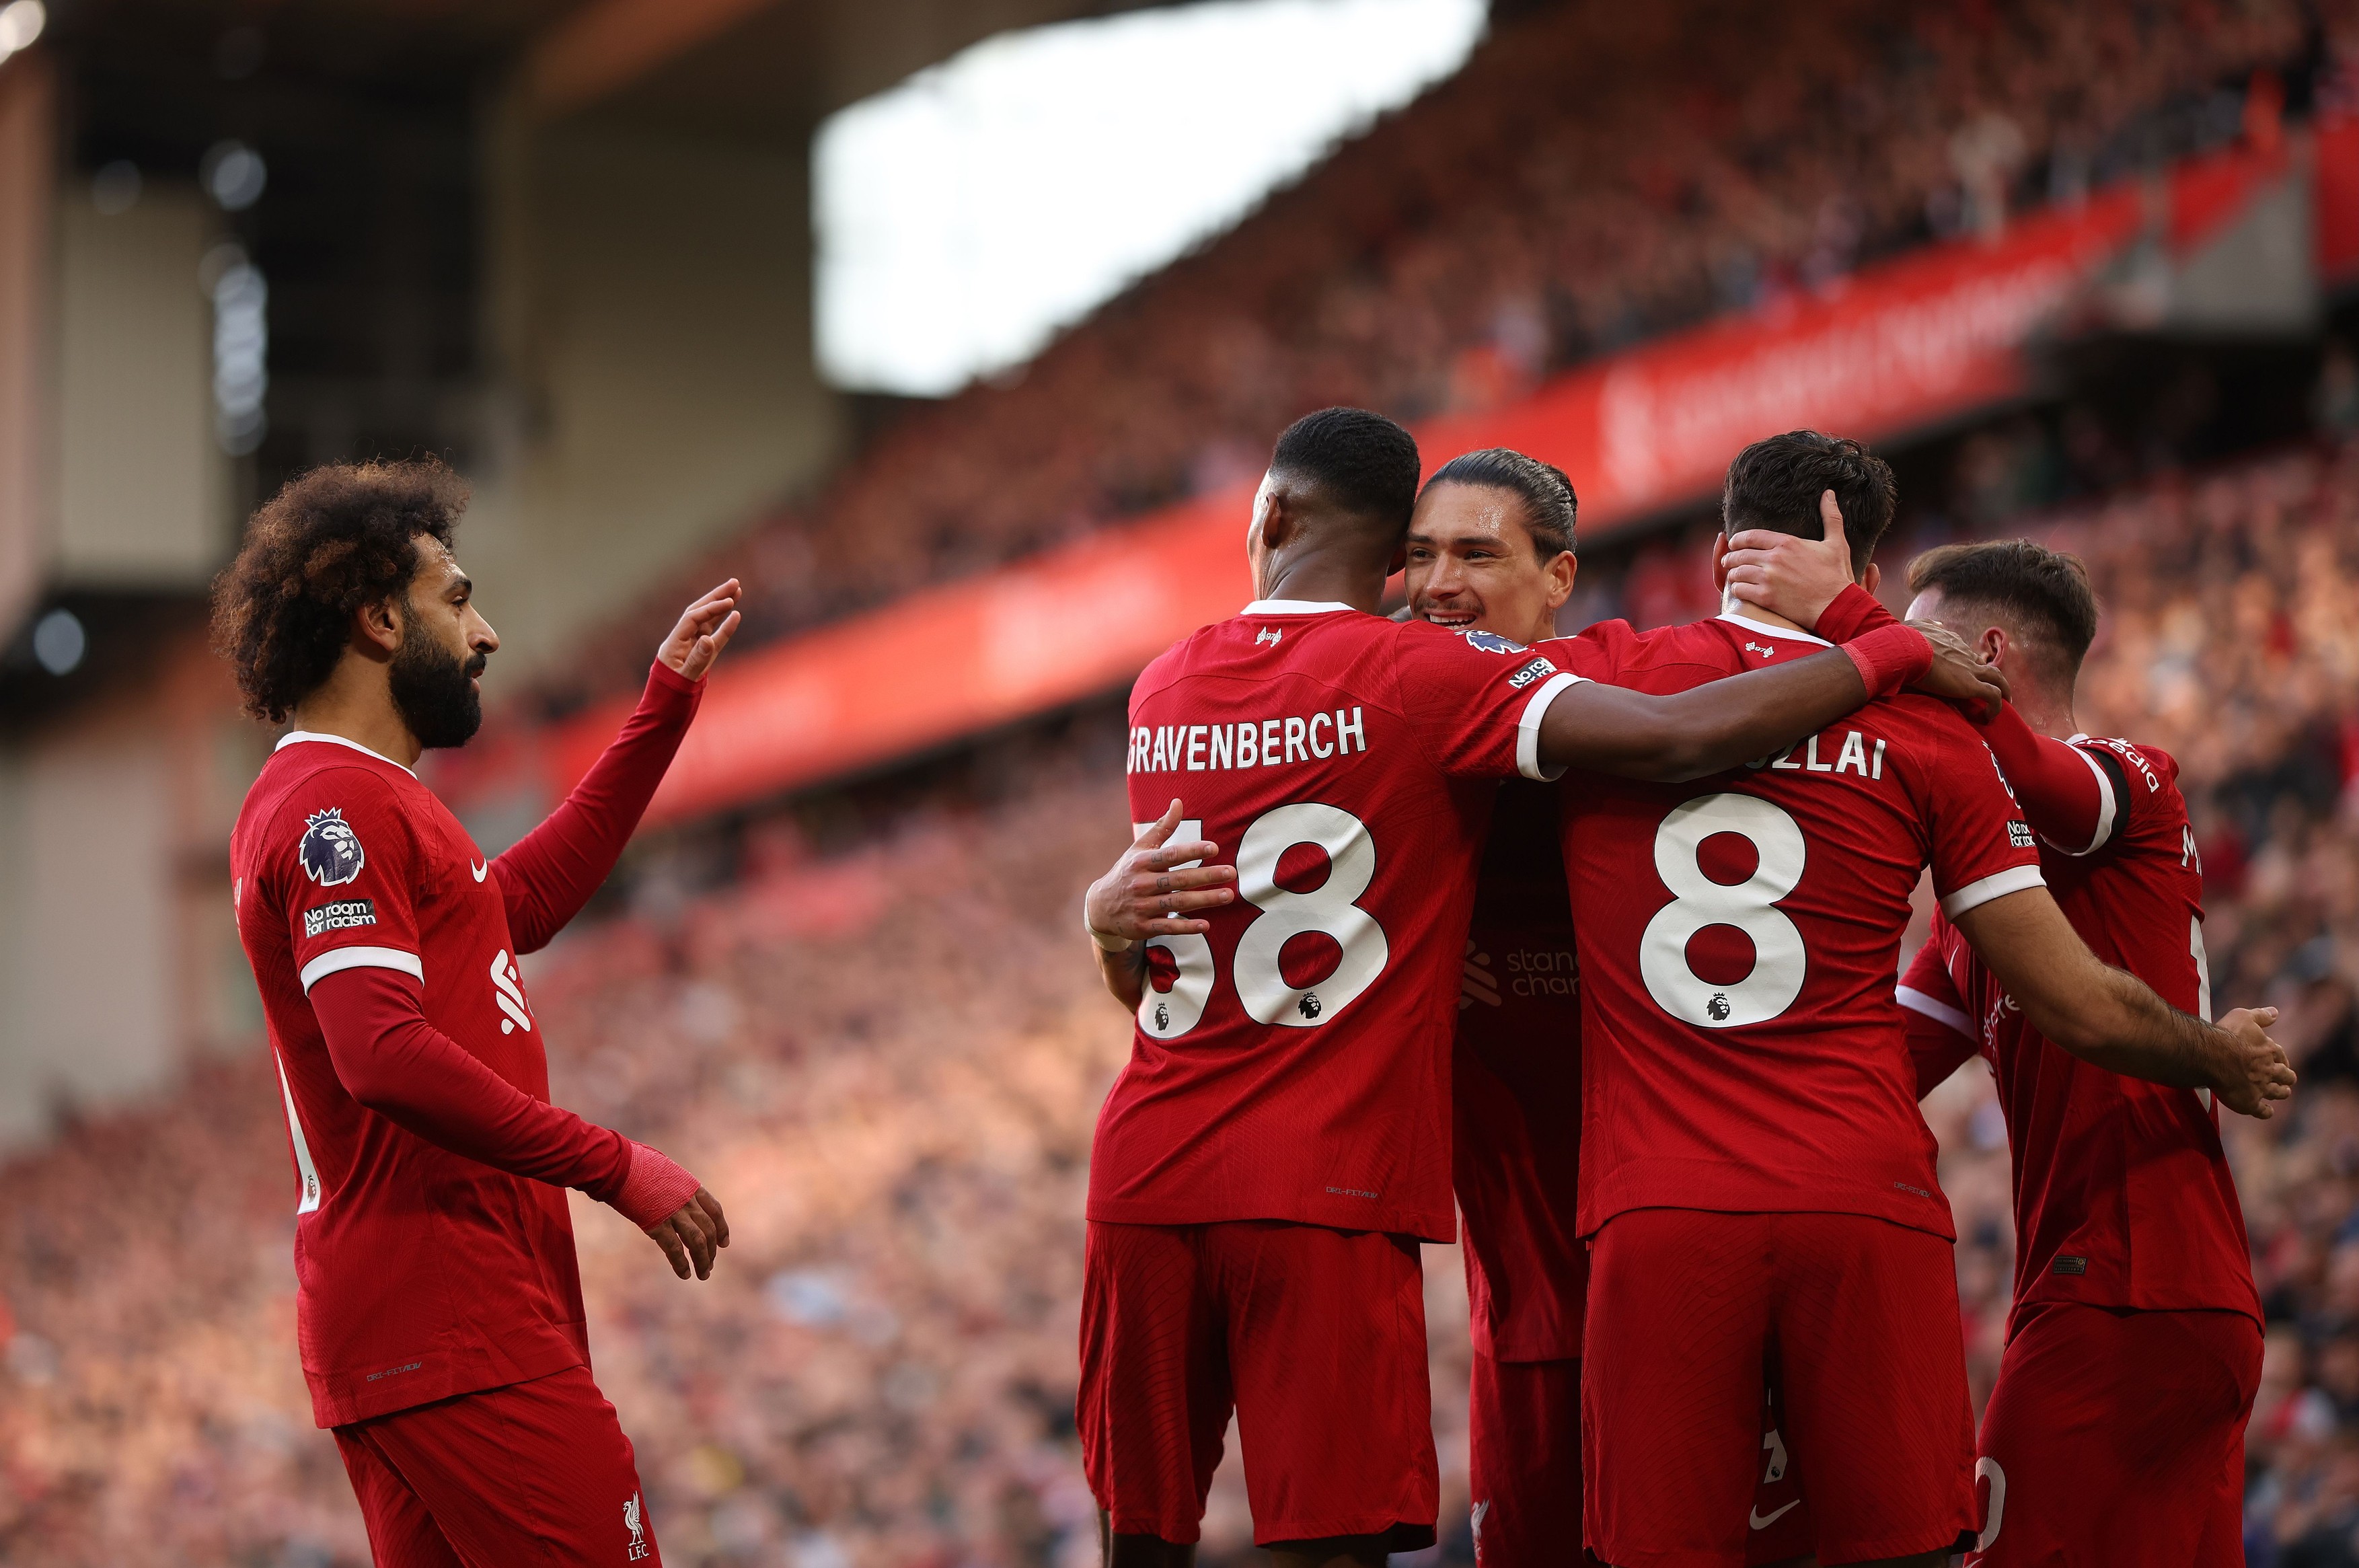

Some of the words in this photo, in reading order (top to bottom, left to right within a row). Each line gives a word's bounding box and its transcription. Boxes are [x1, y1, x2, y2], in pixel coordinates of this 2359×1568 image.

[1127, 706, 1366, 775] GRAVENBERCH
[2007, 821, 2021, 834] No
[304, 909, 324, 926] No
[326, 902, 367, 918] room
[1639, 792, 1807, 1028] 8
[306, 921, 324, 938] for
[326, 913, 377, 930] racism
[1507, 948, 1580, 971] stan
